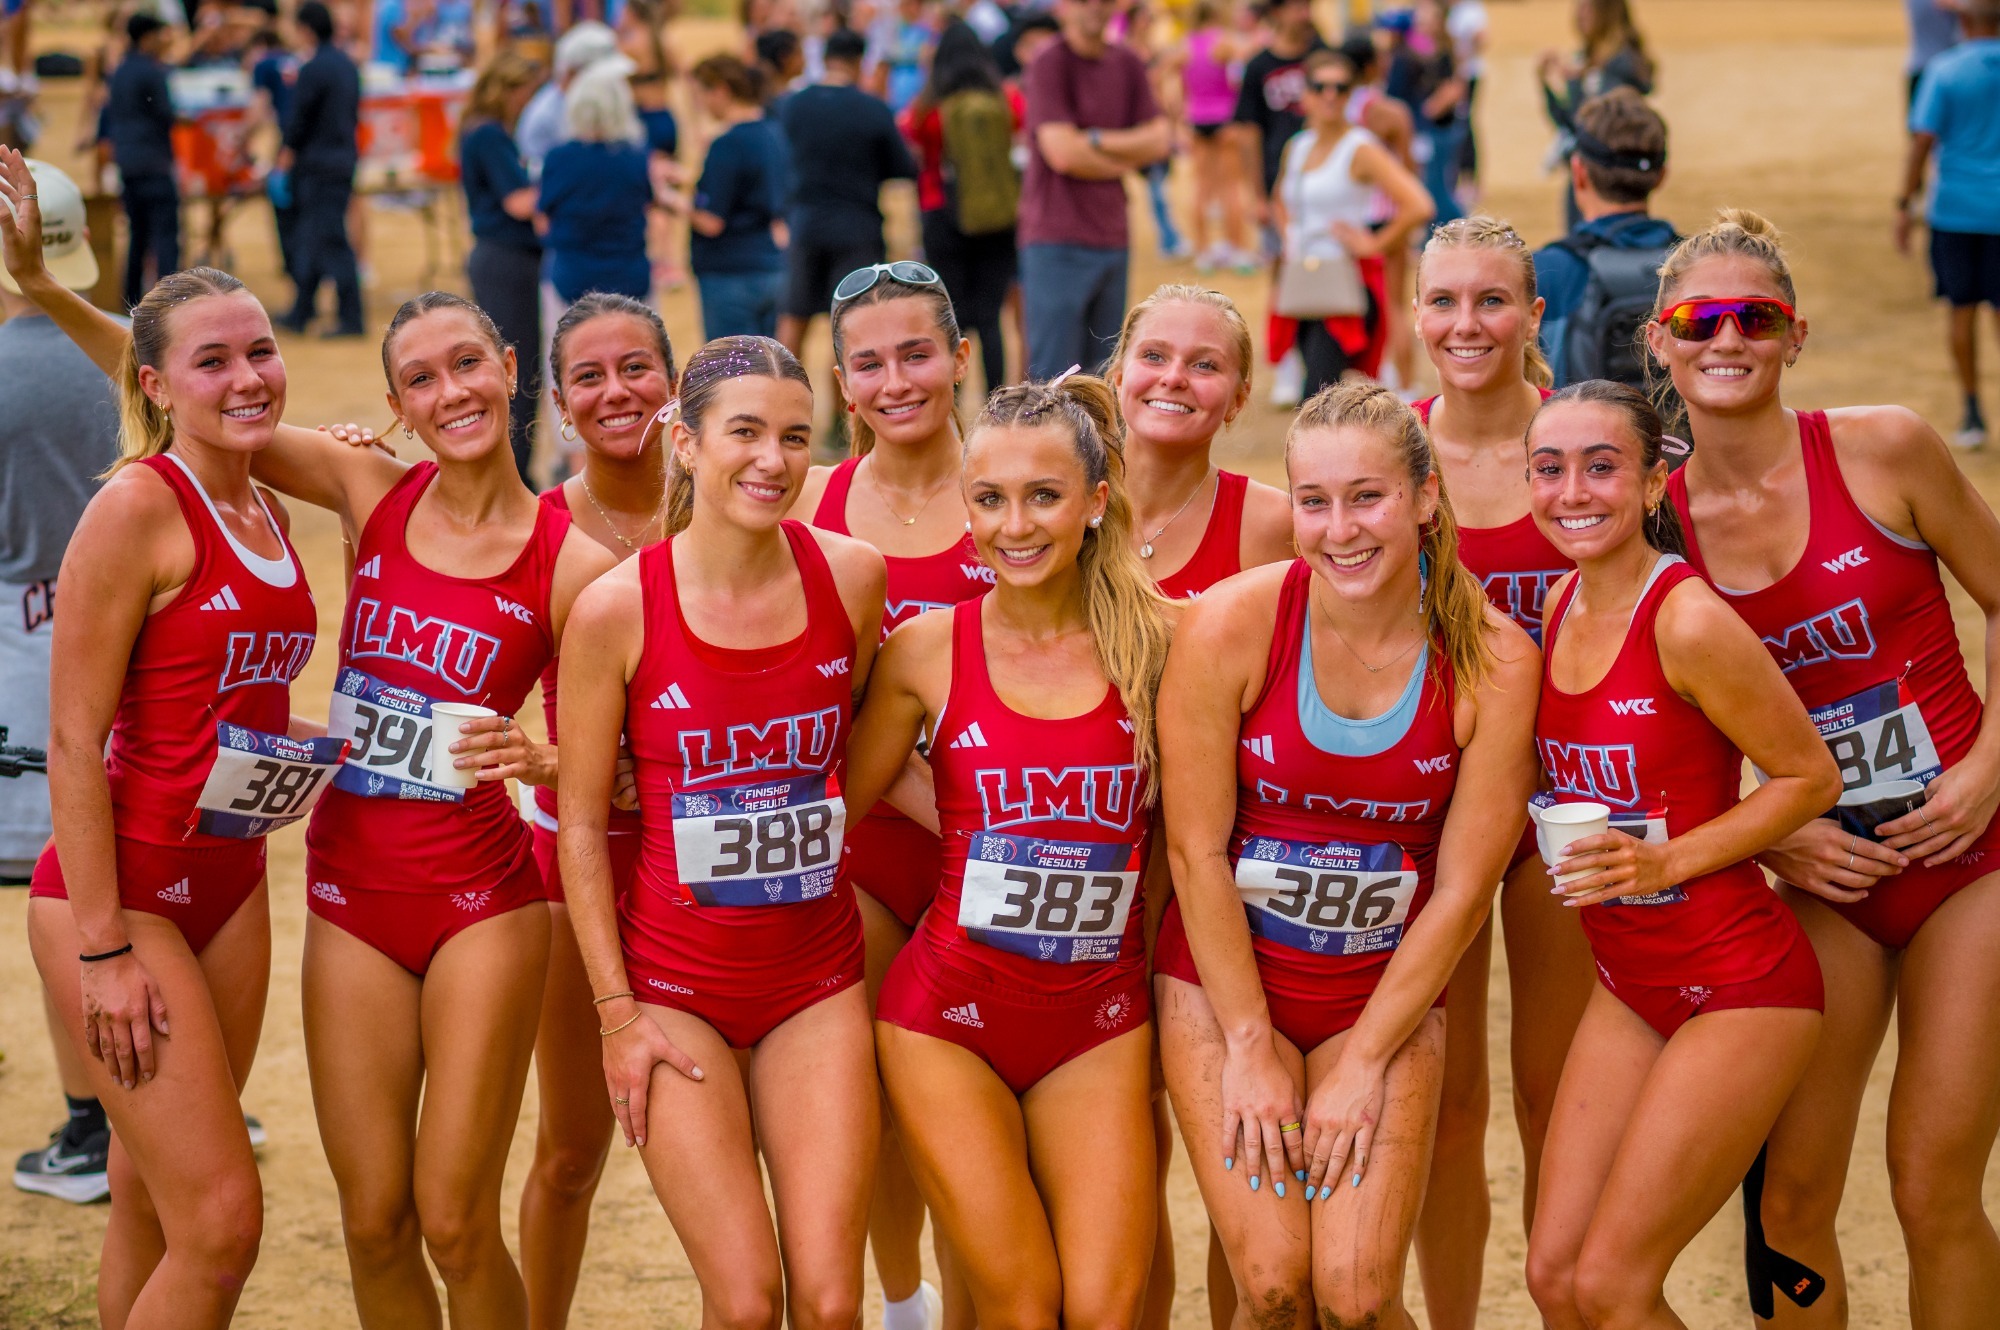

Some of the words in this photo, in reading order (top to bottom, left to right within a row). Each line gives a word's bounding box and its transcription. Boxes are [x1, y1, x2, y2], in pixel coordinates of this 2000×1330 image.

[1821, 546, 1870, 574] WCC
[494, 595, 534, 625] WCC
[1761, 597, 1877, 675] MU
[351, 597, 502, 695] LMU
[815, 656, 849, 678] WCC
[378, 695, 422, 714] RESULTS
[1608, 698, 1657, 716] WCC
[1815, 715, 1855, 735] ESULTS
[276, 747, 313, 762] RESULTS
[678, 704, 840, 787] LMU
[1824, 712, 1917, 793] 84
[1413, 753, 1451, 775] WCC
[1536, 735, 1640, 808] MU
[229, 759, 326, 815] 381
[424, 788, 441, 799] SCAN
[442, 792, 456, 802] FOR
[744, 784, 791, 800] FINISHED
[744, 797, 788, 812] RESULTS
[975, 764, 1141, 832] LMU
[711, 804, 832, 877] 388
[1042, 845, 1091, 857] FINISHED
[1038, 857, 1087, 869] RESULTS
[1310, 857, 1360, 869] RESULTS
[157, 889, 192, 905] adidas
[312, 885, 347, 905] adidas
[990, 868, 1124, 933] 383
[1266, 867, 1402, 928] 386
[1366, 936, 1383, 945] YOUR
[1367, 929, 1384, 938] SCAN
[1383, 926, 1396, 935] FOR
[1093, 938, 1109, 946] SCAN
[1365, 940, 1394, 951] DISCOUNT
[1089, 952, 1116, 960] DISCOUNT
[648, 978, 695, 995] adidas
[942, 1010, 985, 1029] adidas
